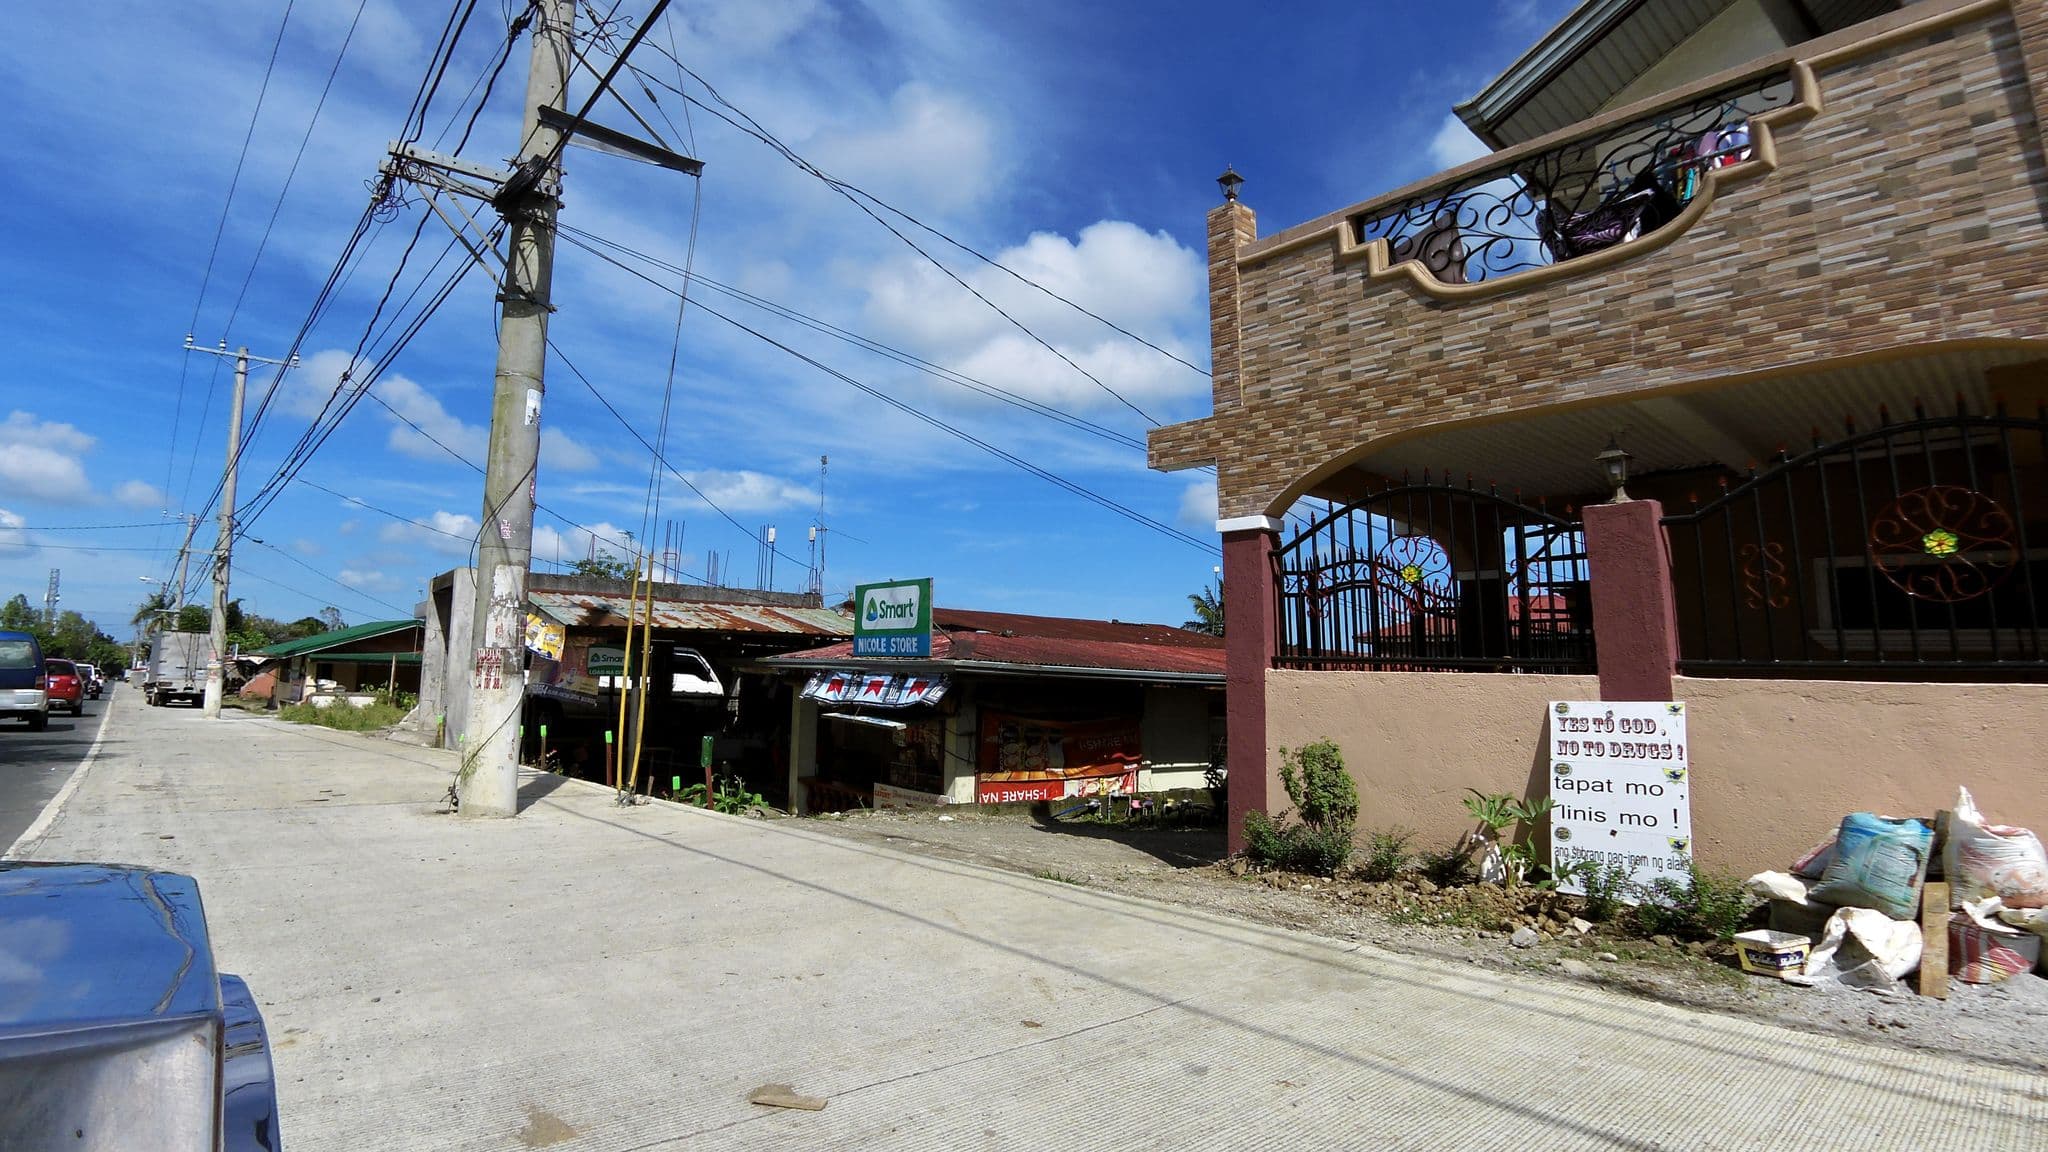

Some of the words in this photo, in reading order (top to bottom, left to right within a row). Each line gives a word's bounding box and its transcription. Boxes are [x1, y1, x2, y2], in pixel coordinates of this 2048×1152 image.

[879, 598, 914, 619] Smart
[858, 637, 887, 653] NICOLE
[890, 636, 918, 653] STORE
[602, 654, 625, 663] Smar
[1557, 717, 1590, 732] YES
[1620, 718, 1657, 734] GOD
[1557, 740, 1580, 756] NO
[1583, 741, 1605, 757] TO
[1608, 742, 1673, 760] DRUGS
[1002, 789, 1047, 803] I-SHARE
[1554, 776, 1614, 795] tapat
[1626, 782, 1664, 797] mo
[1561, 804, 1607, 823] linis
[1620, 812, 1658, 828] mo
[1554, 846, 1569, 862] ang
[1652, 855, 1664, 872] ng
